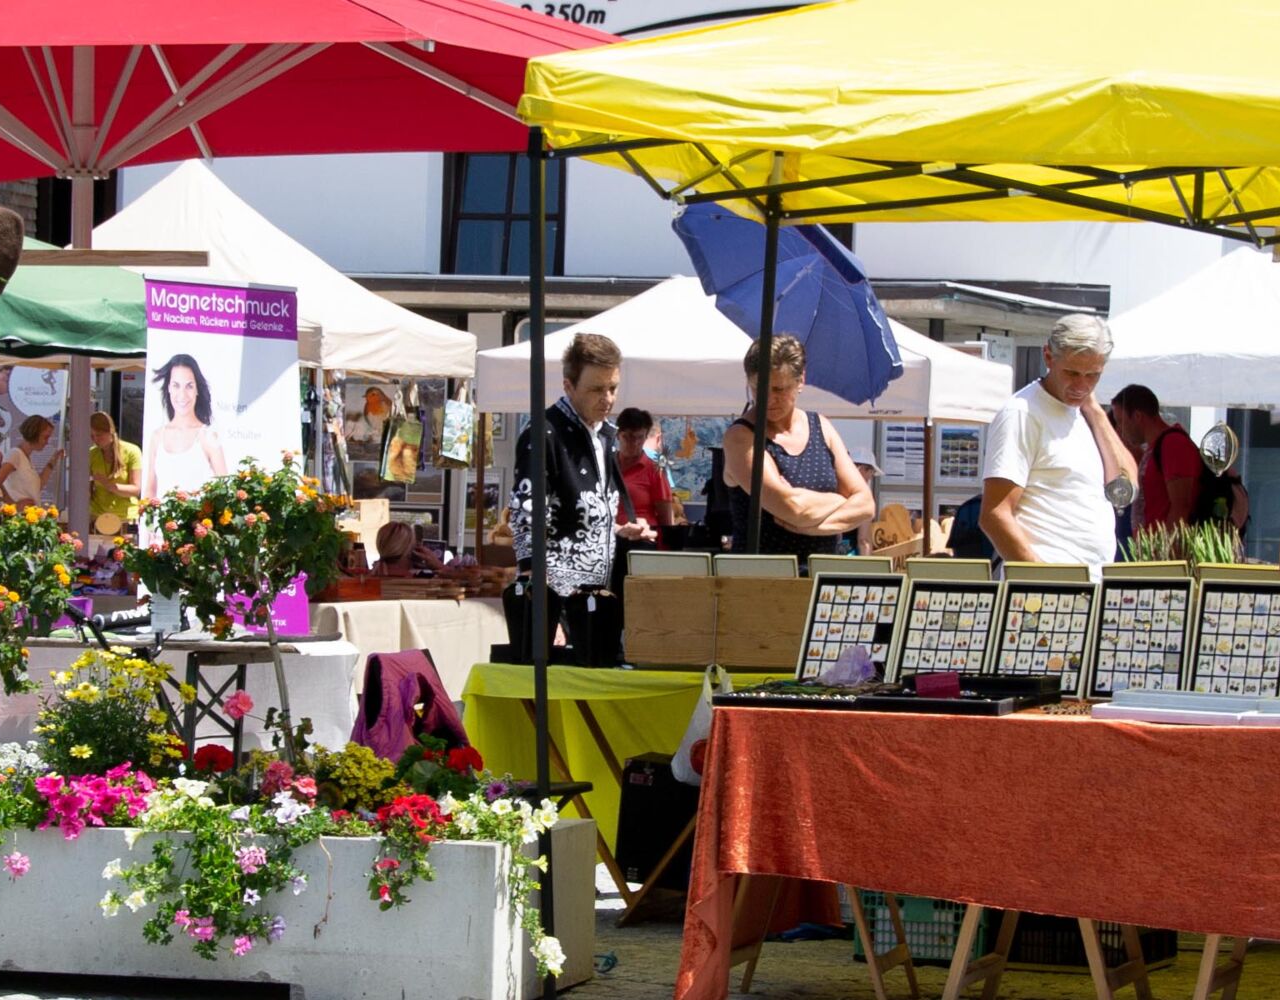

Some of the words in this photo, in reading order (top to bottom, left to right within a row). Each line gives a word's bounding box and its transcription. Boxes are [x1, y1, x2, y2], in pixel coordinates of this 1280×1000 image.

[151, 287, 290, 318] Magnetschmuck
[151, 312, 161, 322] für
[163, 313, 197, 326] Nacken,
[200, 315, 229, 327] Rücken
[231, 318, 247, 329] und
[249, 320, 284, 332] Gelenke
